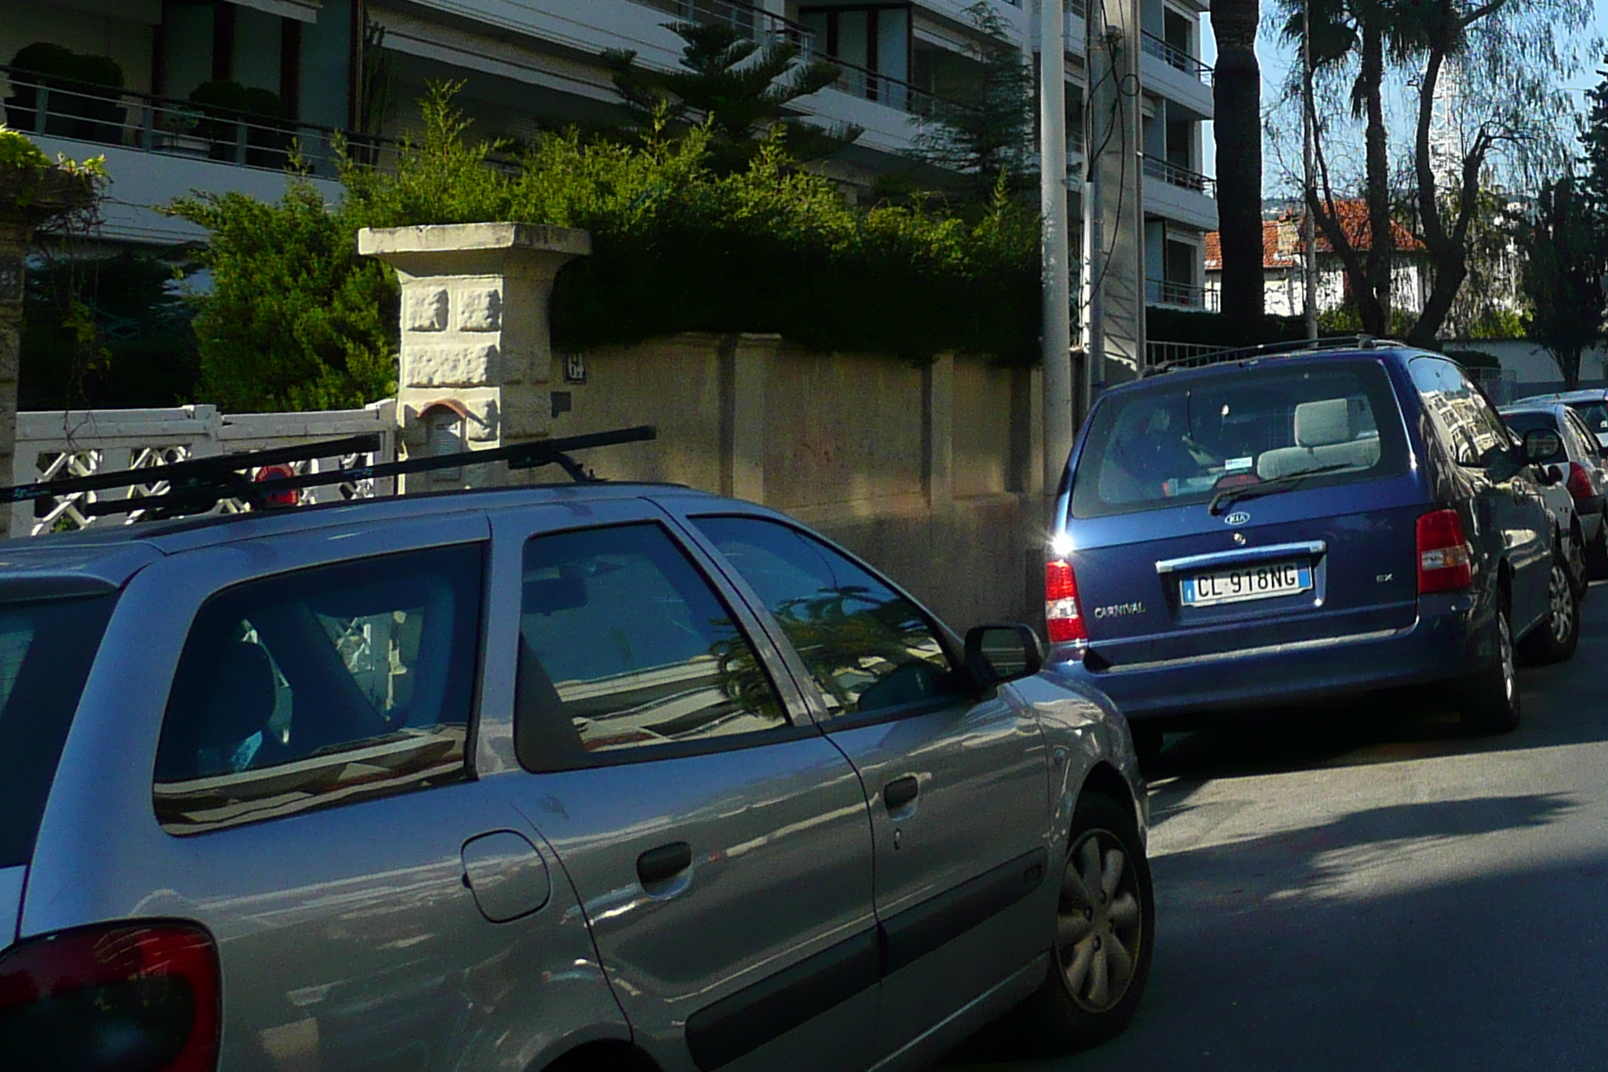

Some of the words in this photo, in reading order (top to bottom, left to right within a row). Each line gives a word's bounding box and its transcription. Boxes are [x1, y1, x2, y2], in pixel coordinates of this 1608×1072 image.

[1197, 575, 1223, 597] CL
[1229, 565, 1296, 593] 918NG
[1094, 602, 1147, 618] CARNIVAL
